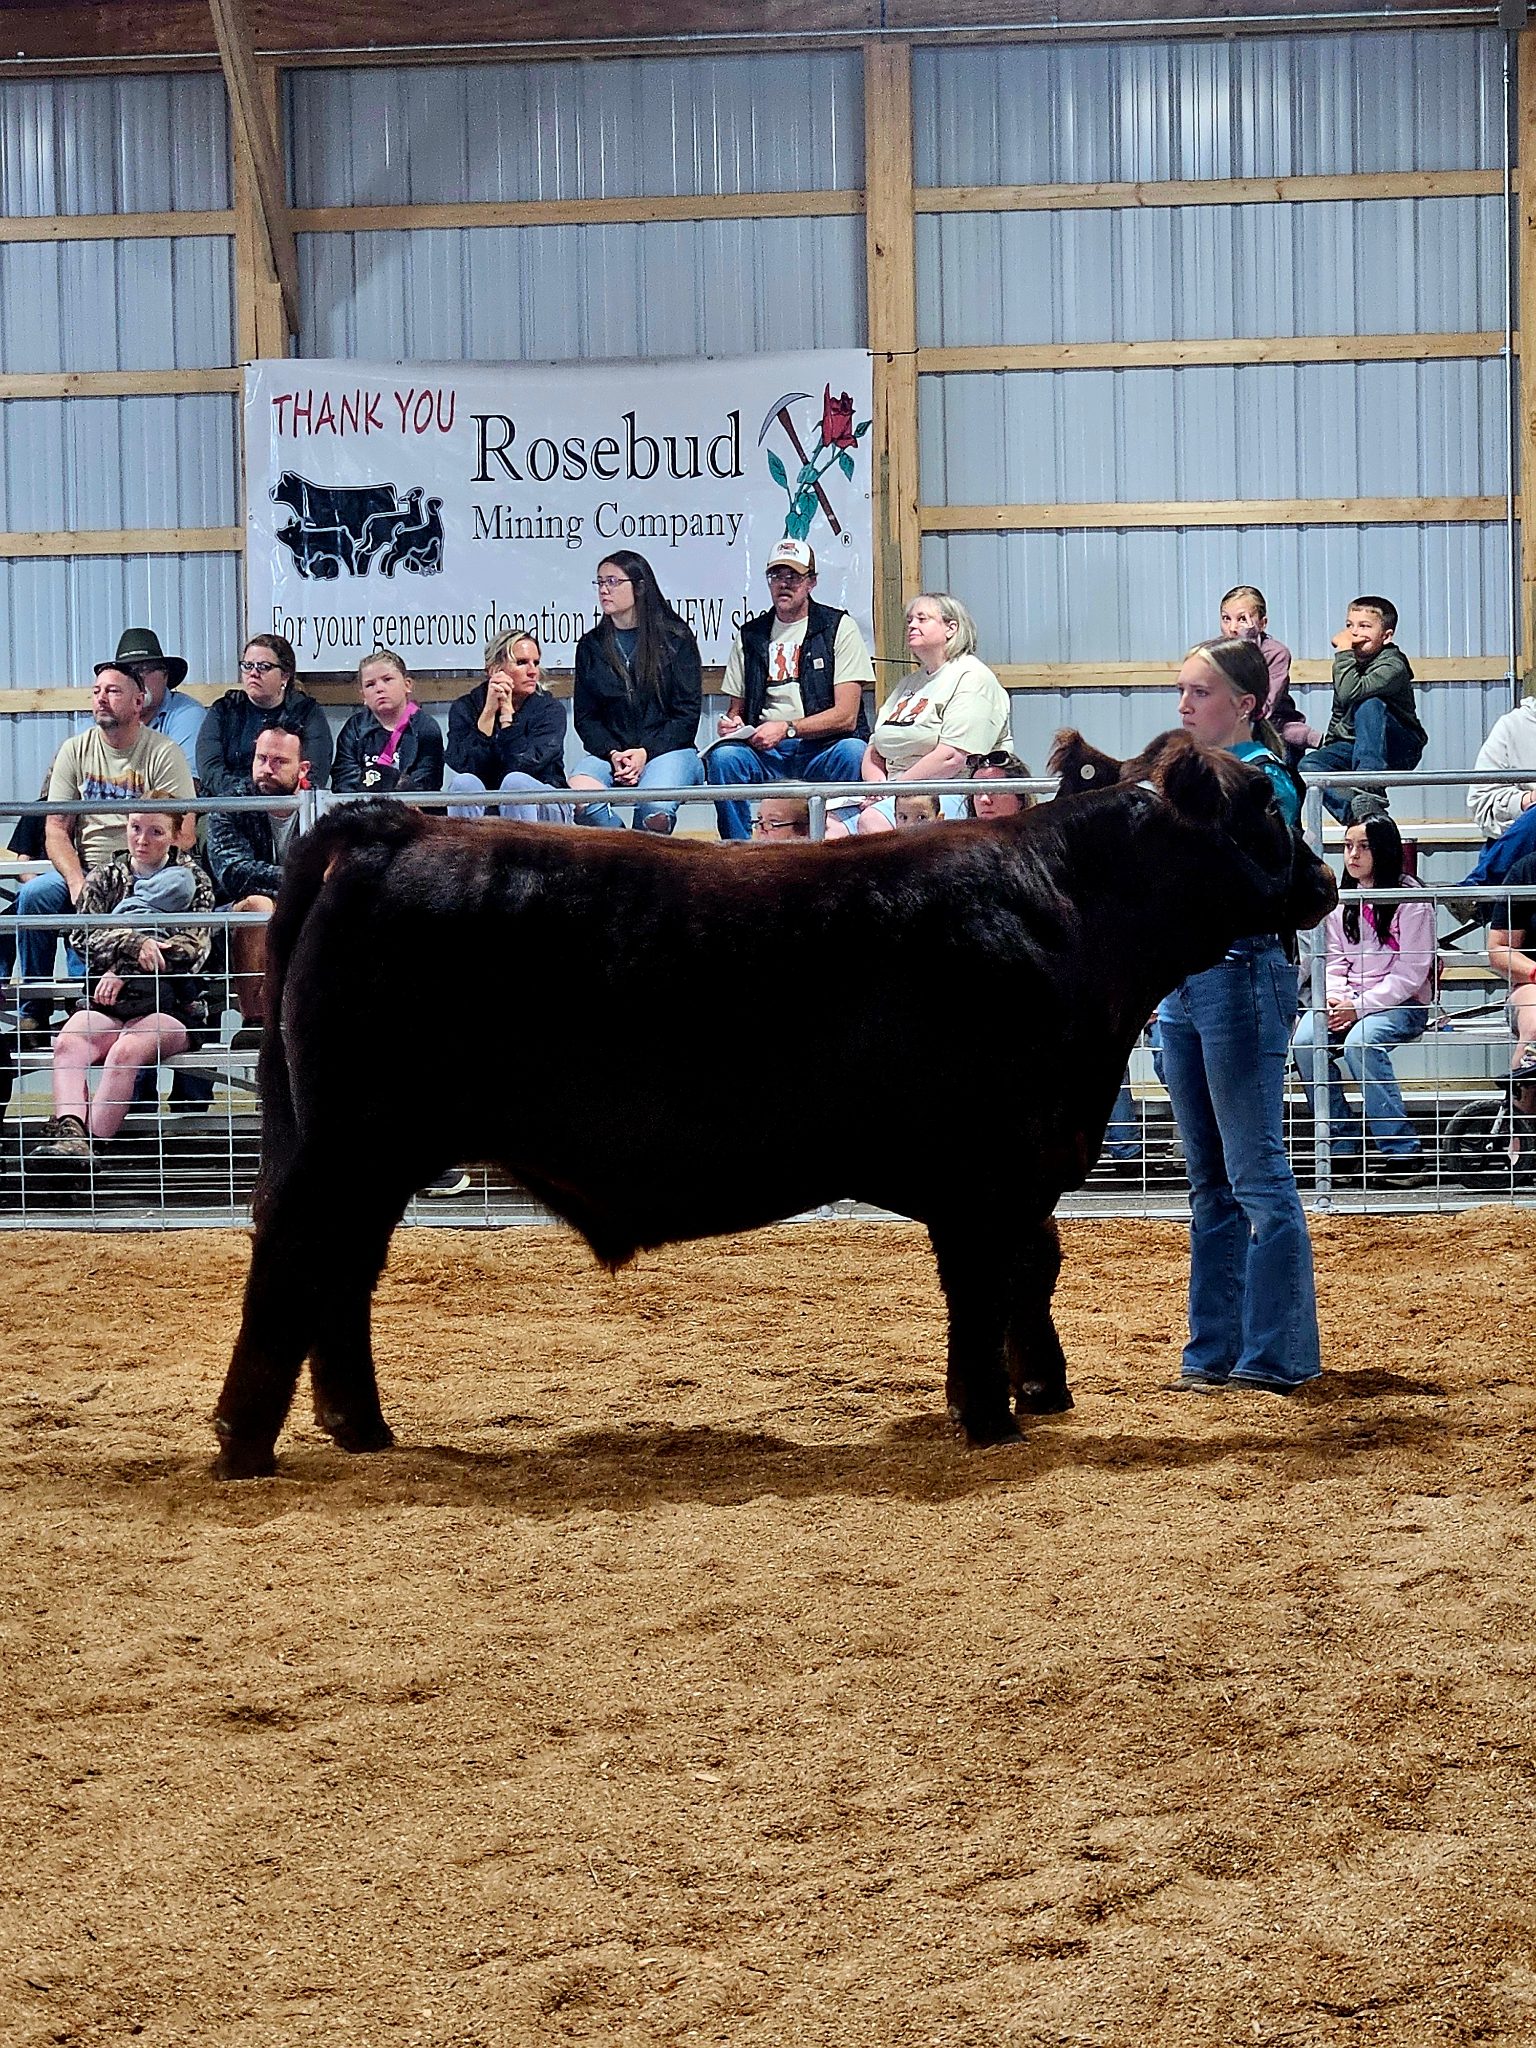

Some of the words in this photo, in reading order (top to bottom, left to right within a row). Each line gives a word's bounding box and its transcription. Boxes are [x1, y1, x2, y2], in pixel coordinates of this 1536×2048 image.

[272, 388, 383, 438] THANK
[394, 388, 455, 435] YOU
[469, 409, 744, 482] Rosebud
[471, 504, 584, 549] Mining
[594, 501, 744, 548] Company
[272, 606, 307, 647] For
[312, 614, 366, 660] your
[372, 613, 477, 654] generous
